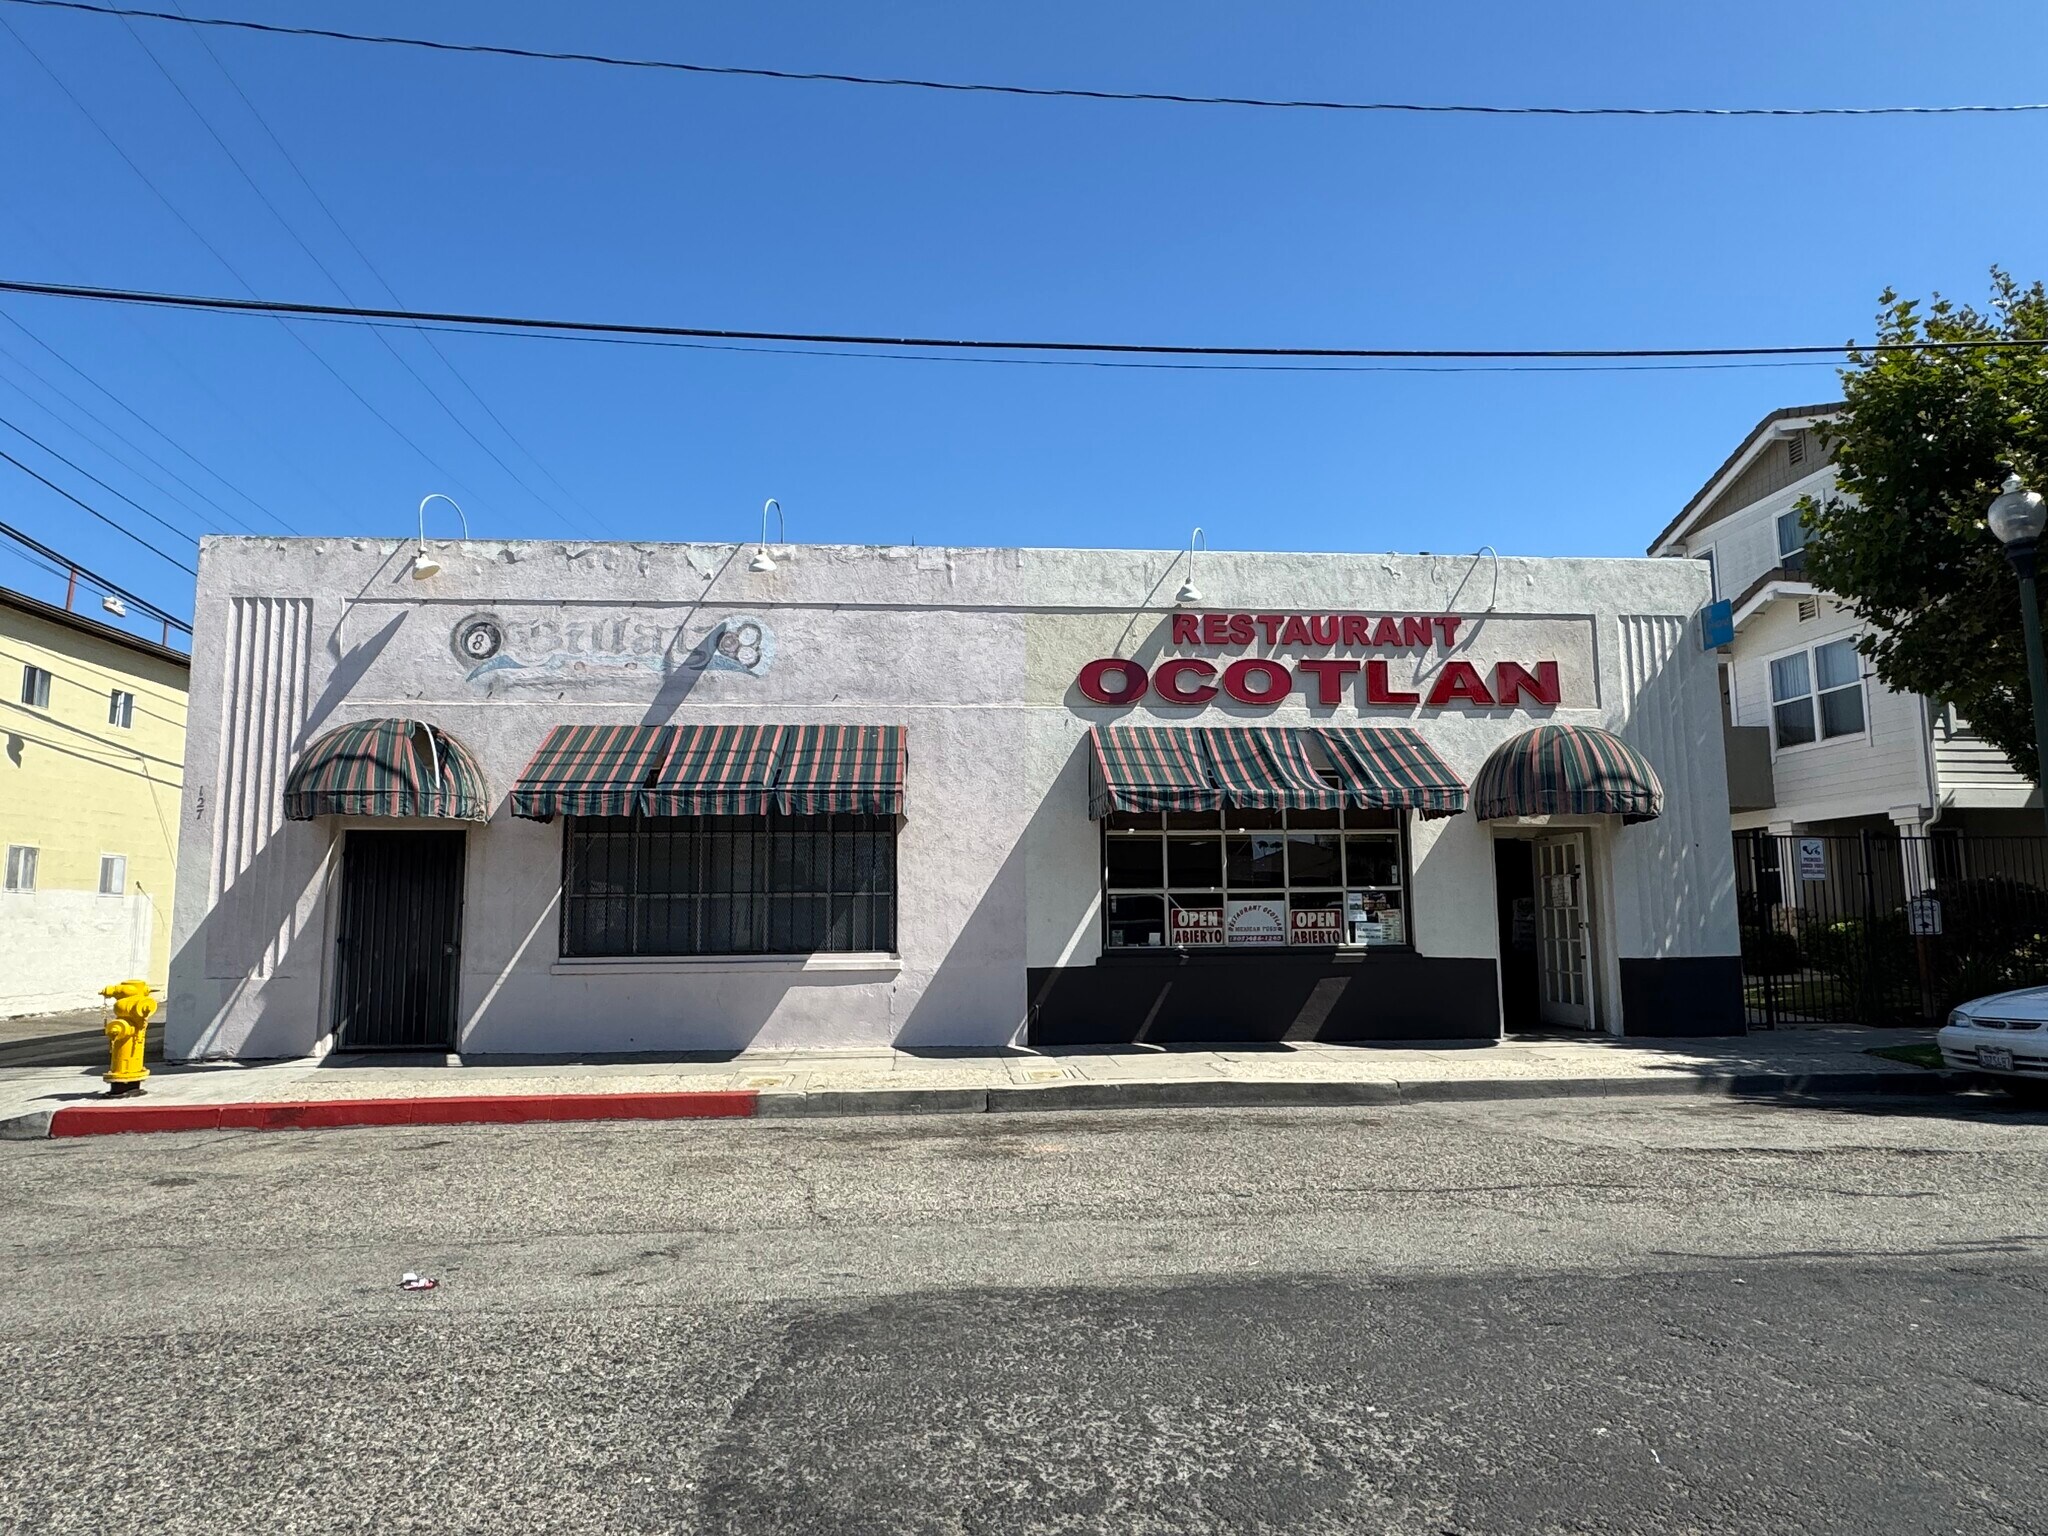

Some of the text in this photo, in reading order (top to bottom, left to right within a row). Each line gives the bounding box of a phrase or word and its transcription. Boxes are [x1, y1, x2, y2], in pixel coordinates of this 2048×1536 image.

[1172, 613, 1462, 647] RESTAURANT
[1077, 658, 1562, 706] OCOTLAN
[196, 785, 205, 820] 127
[1177, 911, 1218, 927] OPEN
[1228, 905, 1283, 932] RESTAURANT OCOTLAN
[1296, 912, 1336, 928] OPEN
[1174, 929, 1222, 944] ABIERTO
[1293, 930, 1340, 944] ABIERTO
